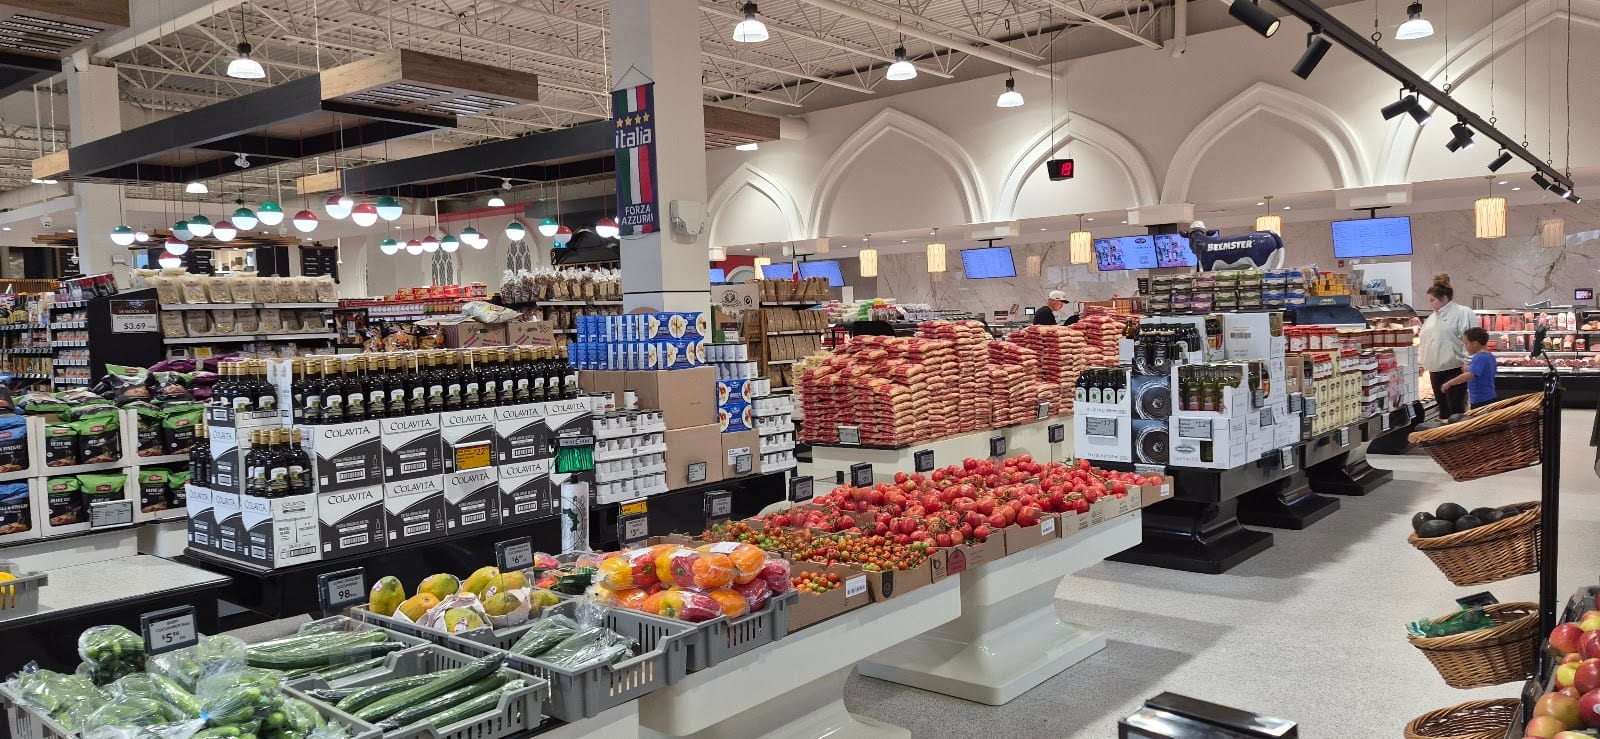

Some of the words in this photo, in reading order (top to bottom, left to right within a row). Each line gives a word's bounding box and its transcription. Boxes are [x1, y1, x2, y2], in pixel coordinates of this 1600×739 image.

[616, 126, 652, 149] italia
[625, 204, 651, 216] FORZA
[621, 213, 654, 226] AZZURRI
[1207, 240, 1253, 252] BEEMSTER
[123, 322, 146, 330] $3.69
[503, 408, 539, 420] COLAVITA
[552, 403, 586, 413] COLAVITA
[390, 419, 432, 432] COLAVITA
[449, 413, 489, 426] COLAVITA
[324, 426, 371, 439] COLAVITA
[506, 464, 542, 476] COLAVITA
[451, 472, 490, 486] COLAVITA
[394, 481, 435, 494] COLAVITA
[328, 490, 374, 505] COLAVITA
[338, 590, 351, 599] 98
